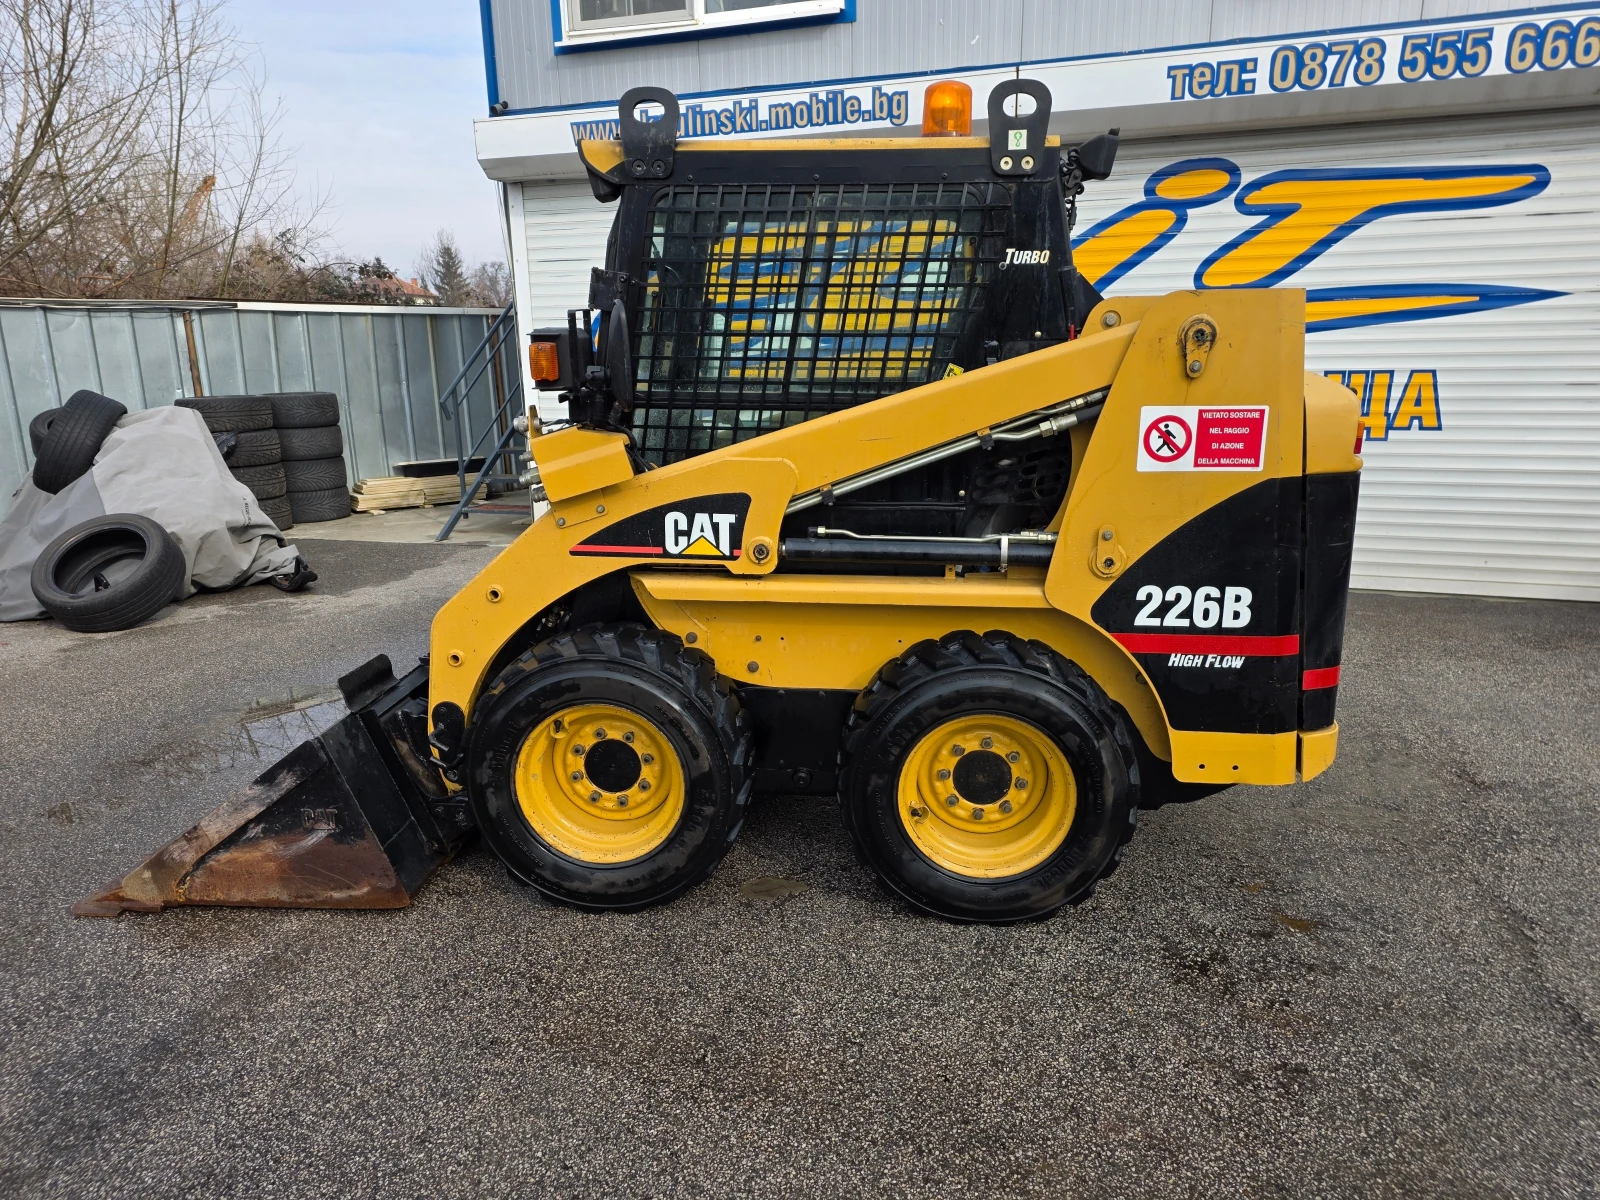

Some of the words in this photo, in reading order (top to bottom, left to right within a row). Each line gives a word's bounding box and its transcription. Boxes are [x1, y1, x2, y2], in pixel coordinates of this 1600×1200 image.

[1167, 57, 1258, 100] тел:
[1268, 38, 1387, 92] 0878
[1398, 27, 1495, 83] 555
[1505, 16, 1600, 74] 666
[1005, 248, 1050, 265] TURBO
[1202, 411, 1229, 419] VIETATO
[1230, 411, 1261, 419] SOSTARE
[1211, 442, 1219, 450] DI
[1220, 442, 1245, 450] AZIONE
[664, 511, 736, 556] CAT
[1133, 585, 1253, 628] 226B
[1167, 653, 1202, 667] HIGH
[1204, 654, 1245, 668] FLOW
[301, 807, 338, 832] CAT
